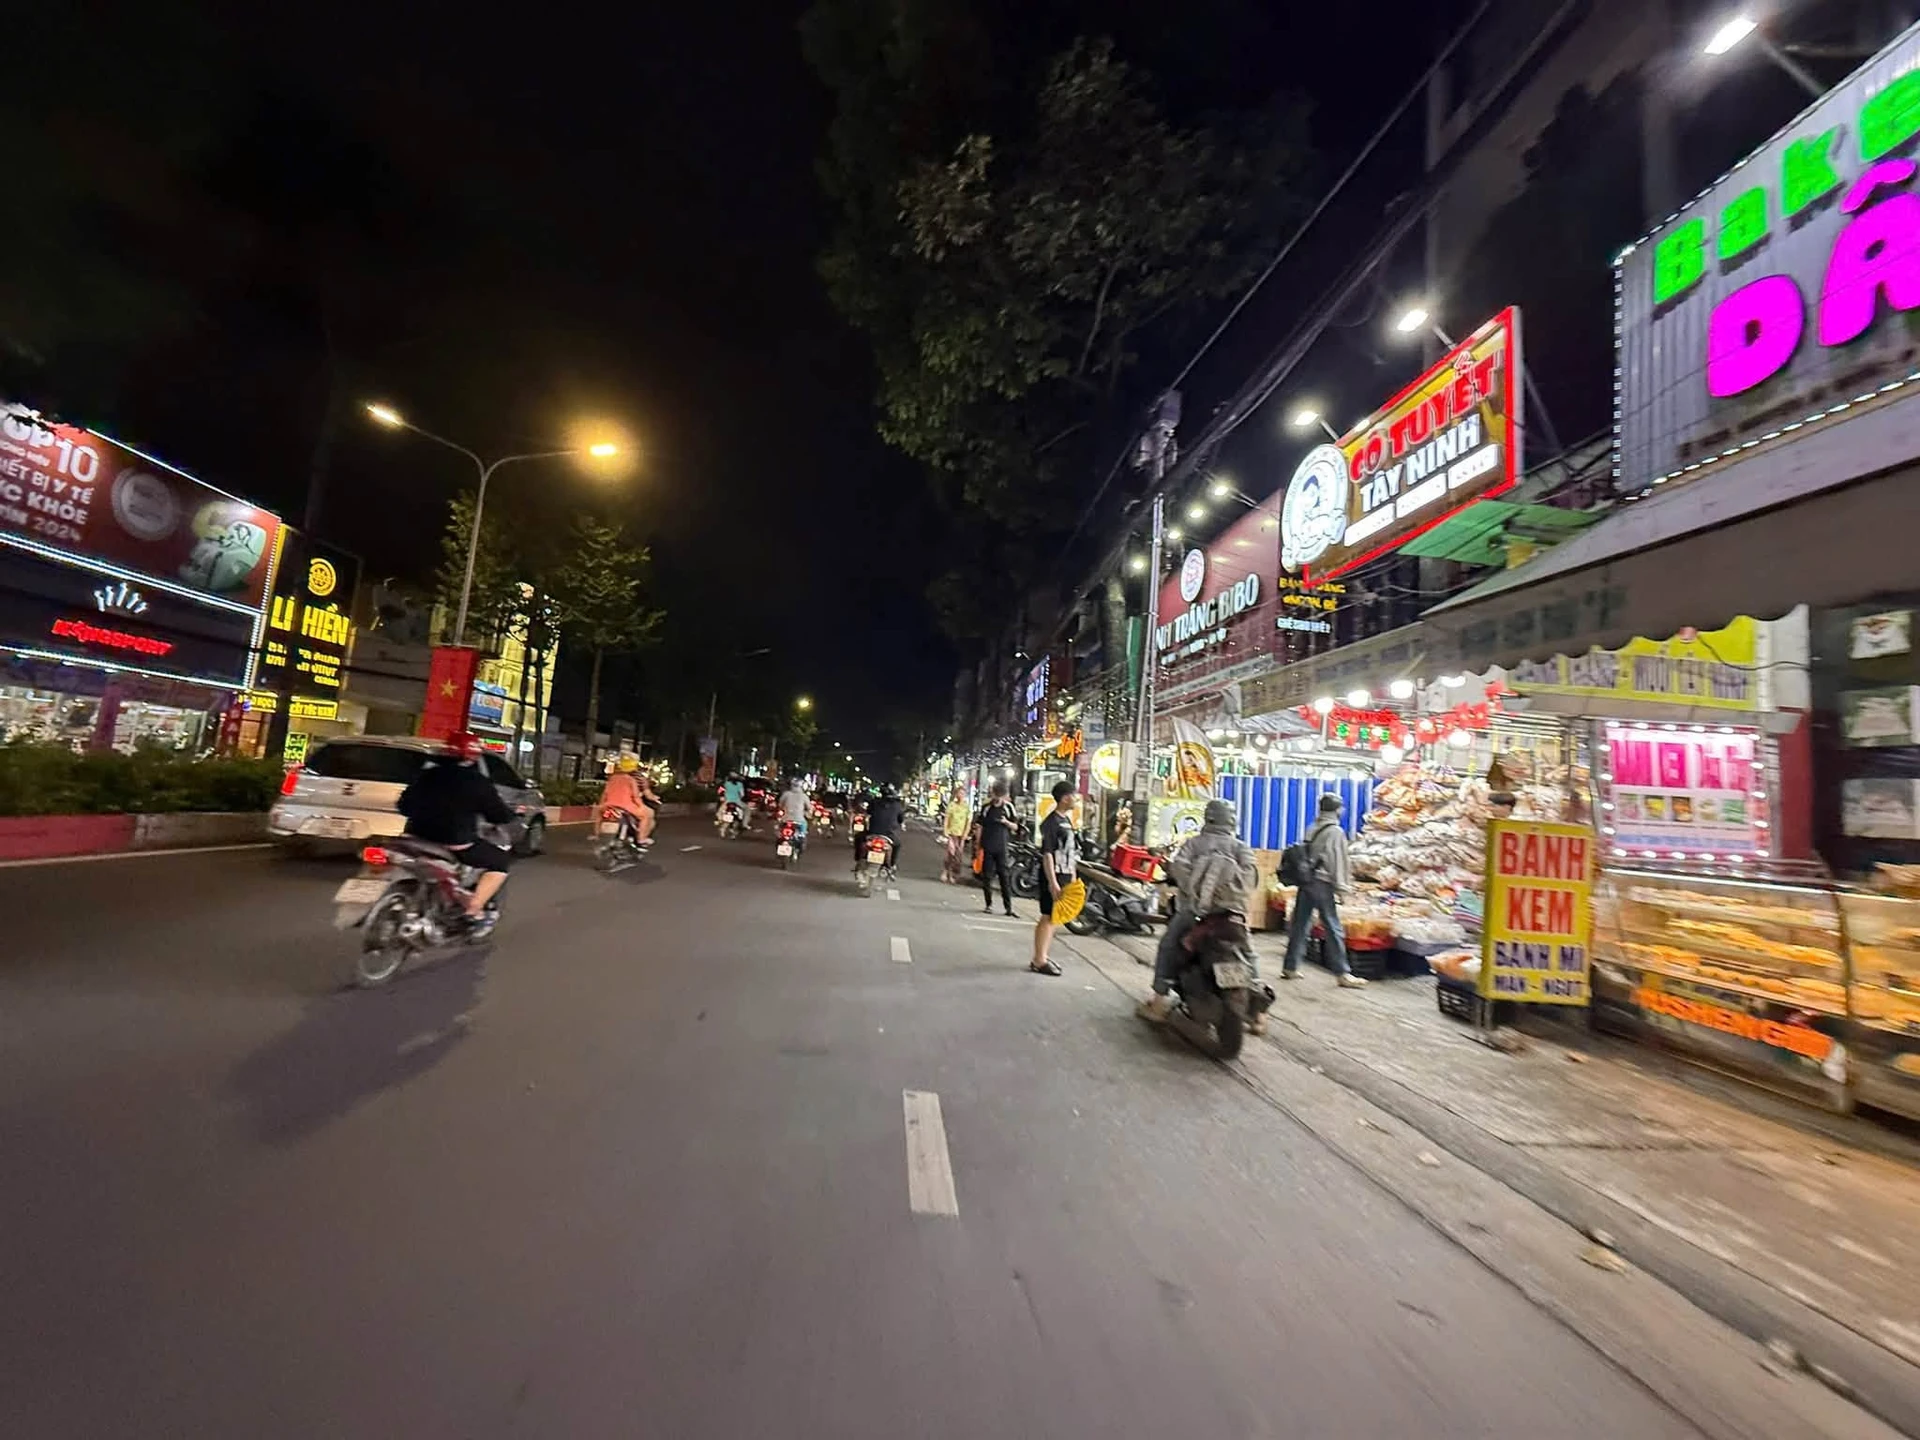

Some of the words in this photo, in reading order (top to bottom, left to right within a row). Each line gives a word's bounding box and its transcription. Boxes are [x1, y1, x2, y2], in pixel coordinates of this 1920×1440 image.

[56, 437, 99, 484] 10
[1359, 463, 1404, 513] TÂY
[1405, 412, 1480, 487] NINH
[1218, 572, 1261, 622] BIBO
[1507, 886, 1576, 935] KEM
